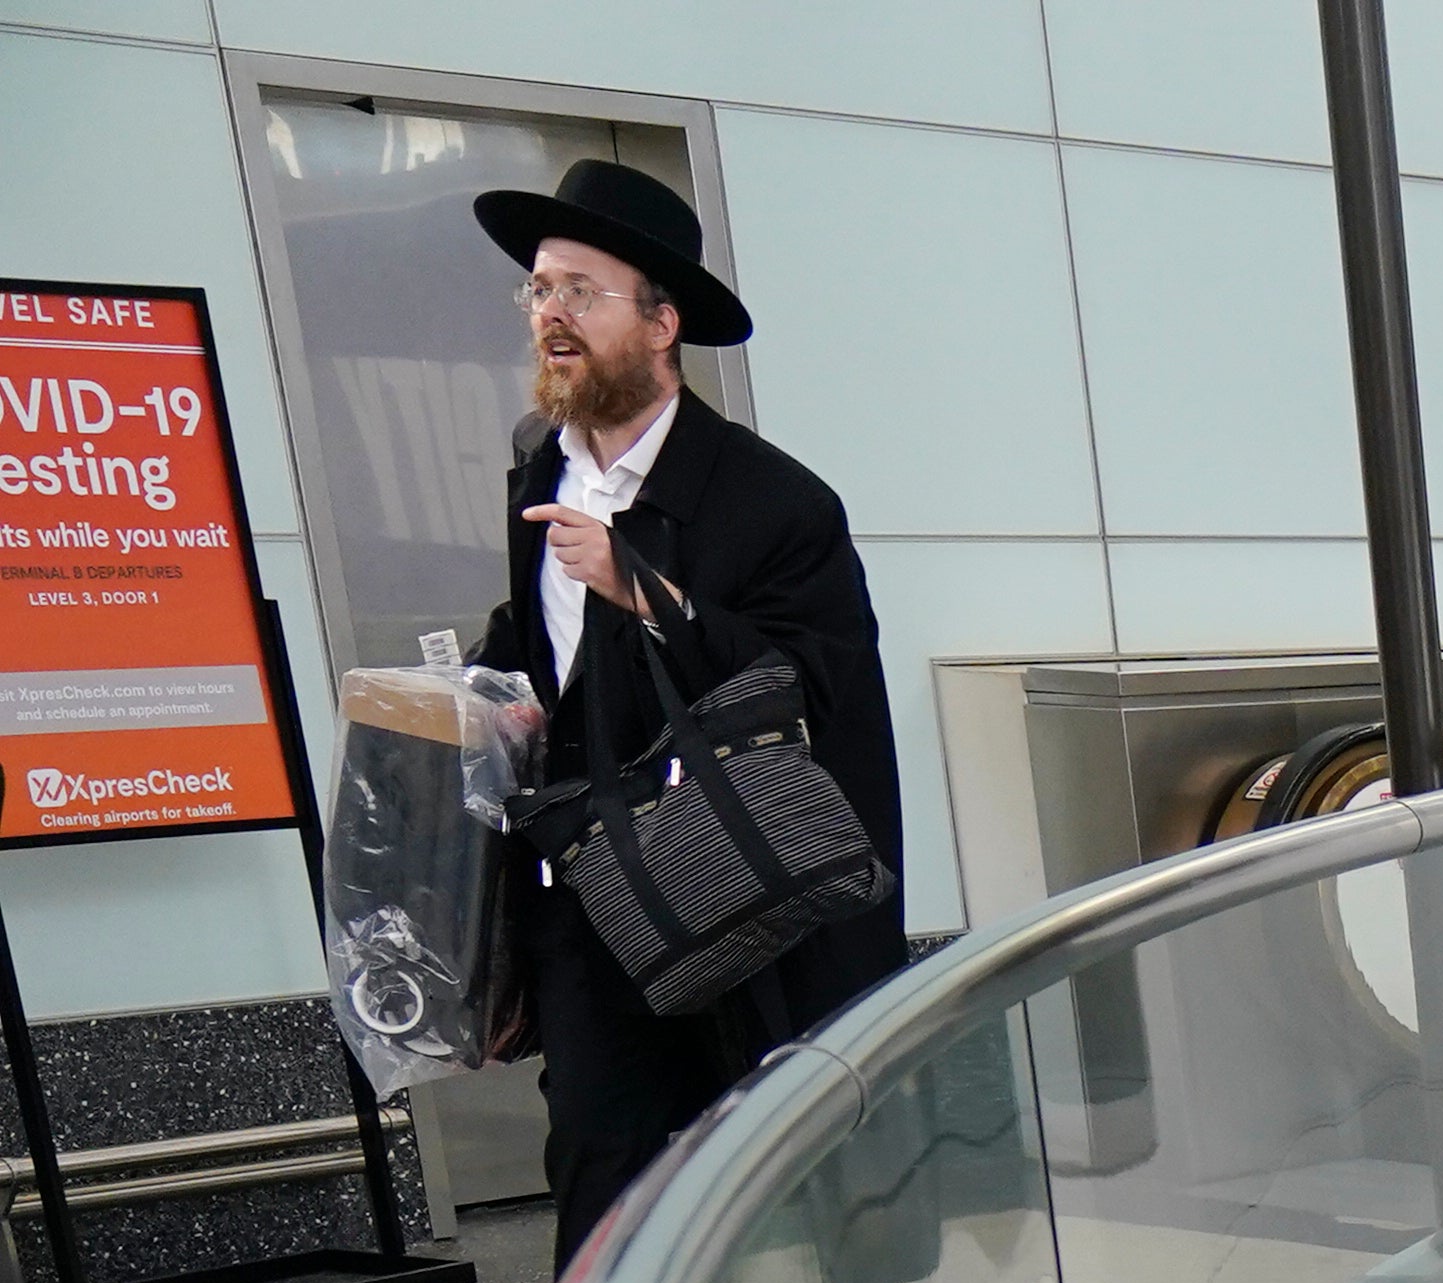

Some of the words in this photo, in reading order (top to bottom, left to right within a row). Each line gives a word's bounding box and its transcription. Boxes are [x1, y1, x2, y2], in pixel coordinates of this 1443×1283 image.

[0, 293, 54, 323] EL
[67, 297, 155, 328] SAFE
[0, 376, 202, 437] VID-19
[37, 522, 110, 548] while
[116, 528, 167, 554] you
[173, 522, 230, 548] wait
[87, 565, 183, 580] DEPARTURES
[28, 592, 78, 606] LEVEL
[83, 592, 98, 606] 3,
[102, 591, 147, 605] DOOR
[151, 591, 160, 604] 1
[17, 683, 146, 704] XpresCheck.com
[149, 685, 162, 697] to
[166, 684, 196, 696] view
[197, 681, 235, 695] hours
[16, 708, 42, 722] and
[45, 706, 107, 721] schedule
[109, 706, 126, 718] an
[129, 703, 214, 719] appointment.
[65, 766, 235, 806] XpresCheck
[40, 812, 102, 829] Clearing
[104, 806, 160, 825] airports
[162, 805, 183, 821] for
[185, 801, 238, 818] takeoff.
